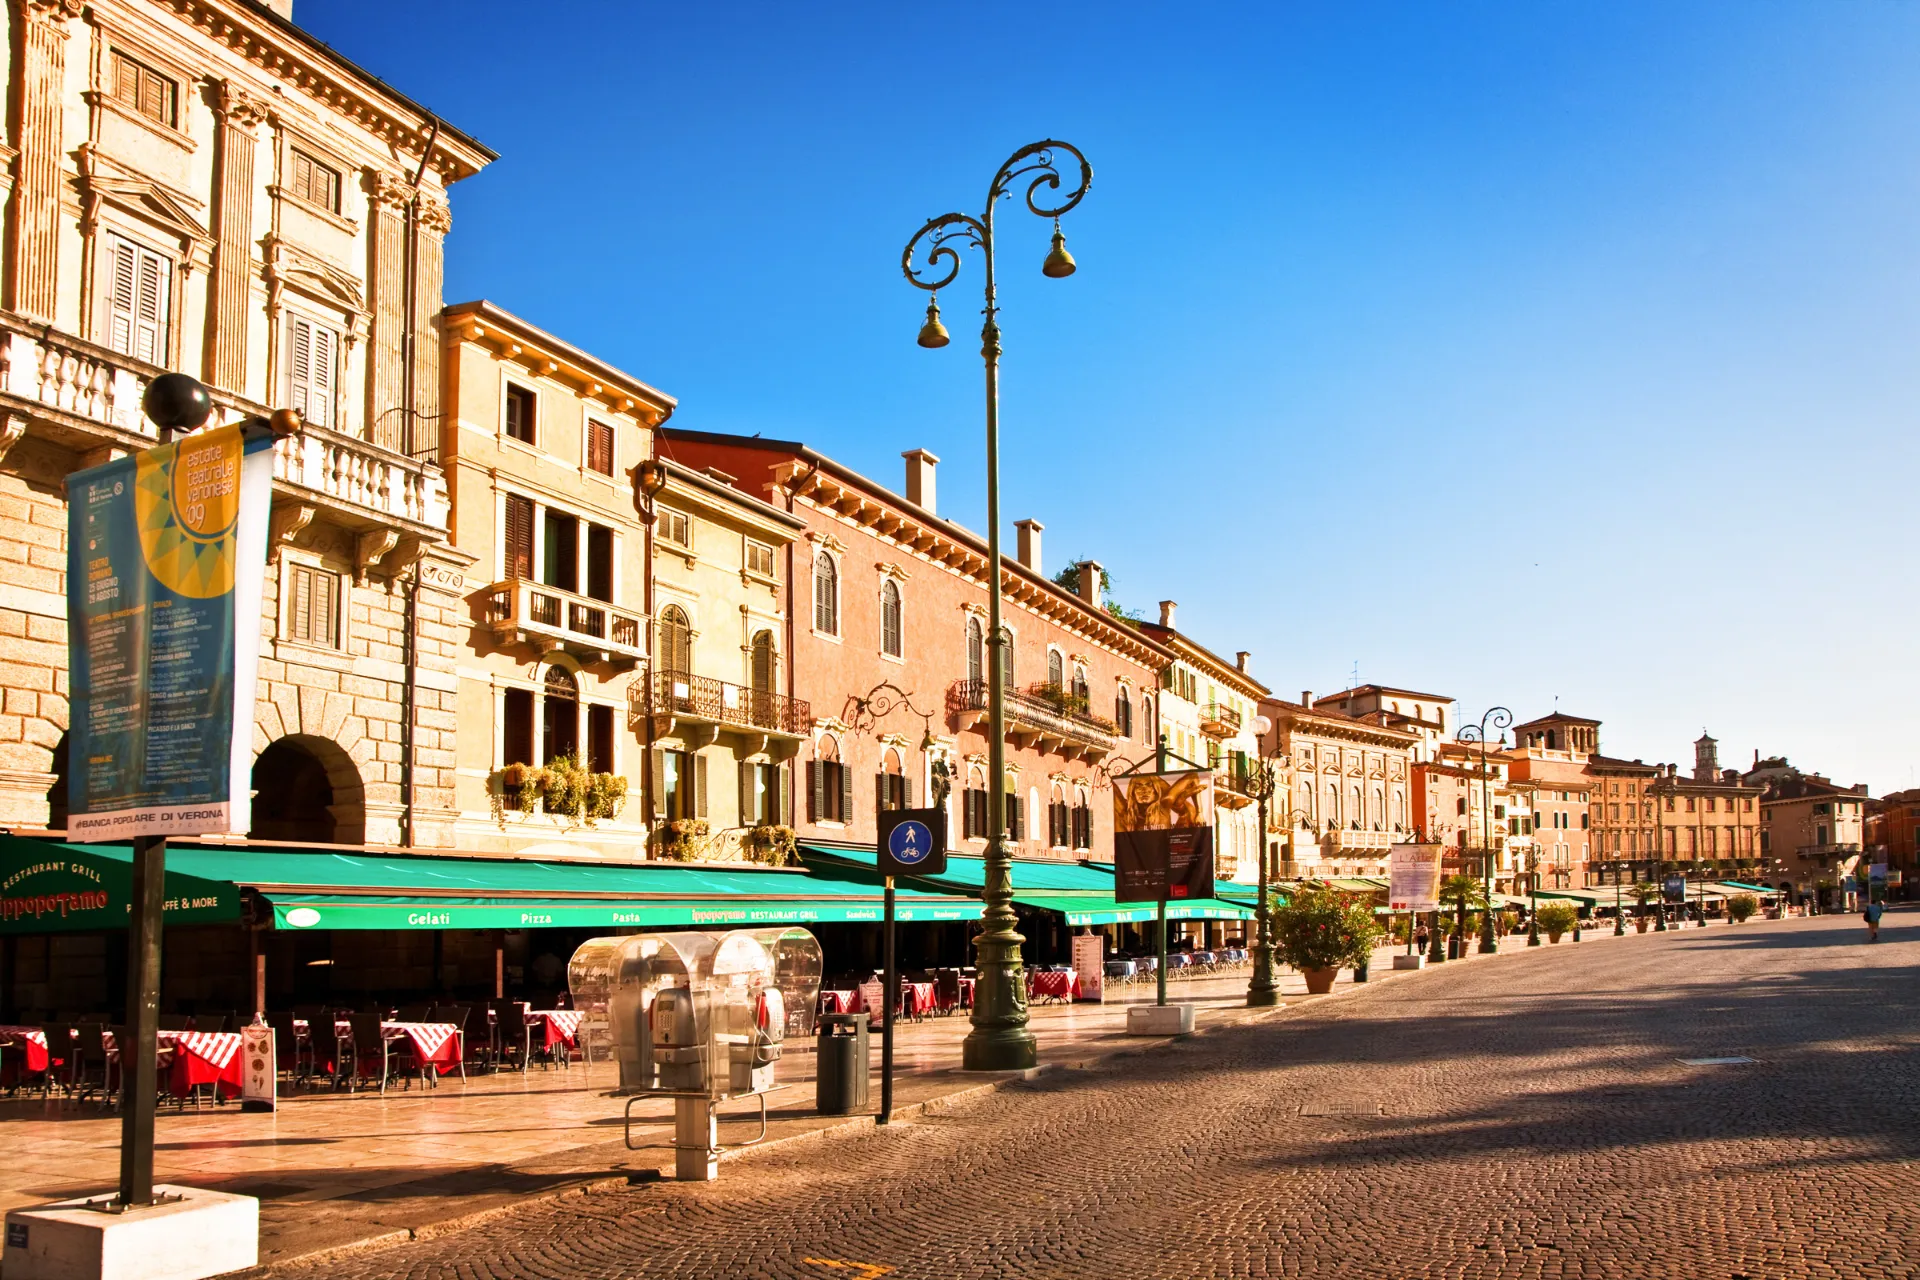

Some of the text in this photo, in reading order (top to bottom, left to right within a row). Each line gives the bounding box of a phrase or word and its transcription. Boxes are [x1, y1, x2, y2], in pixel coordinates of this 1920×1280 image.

[187, 444, 222, 467] estate
[187, 459, 235, 487] teatrale
[187, 480, 235, 503] veronese
[88, 557, 109, 570] TEATRO
[96, 577, 118, 591] GIUGNO
[96, 588, 119, 602] AGOSTO
[147, 725, 169, 733] PICASSO
[82, 809, 224, 828] BANCA POPOLARE DI VERONA
[2, 862, 101, 890] RESTAURANT GRILL
[161, 897, 218, 911] FFÈ & MORE
[408, 912, 450, 926] Gelati
[521, 913, 552, 924] Pizza
[612, 912, 641, 923] Pasta
[750, 910, 798, 920] RESTAURANT
[799, 910, 818, 920] GRILL
[846, 909, 877, 919] Sandwich
[1116, 911, 1132, 922] BAR
